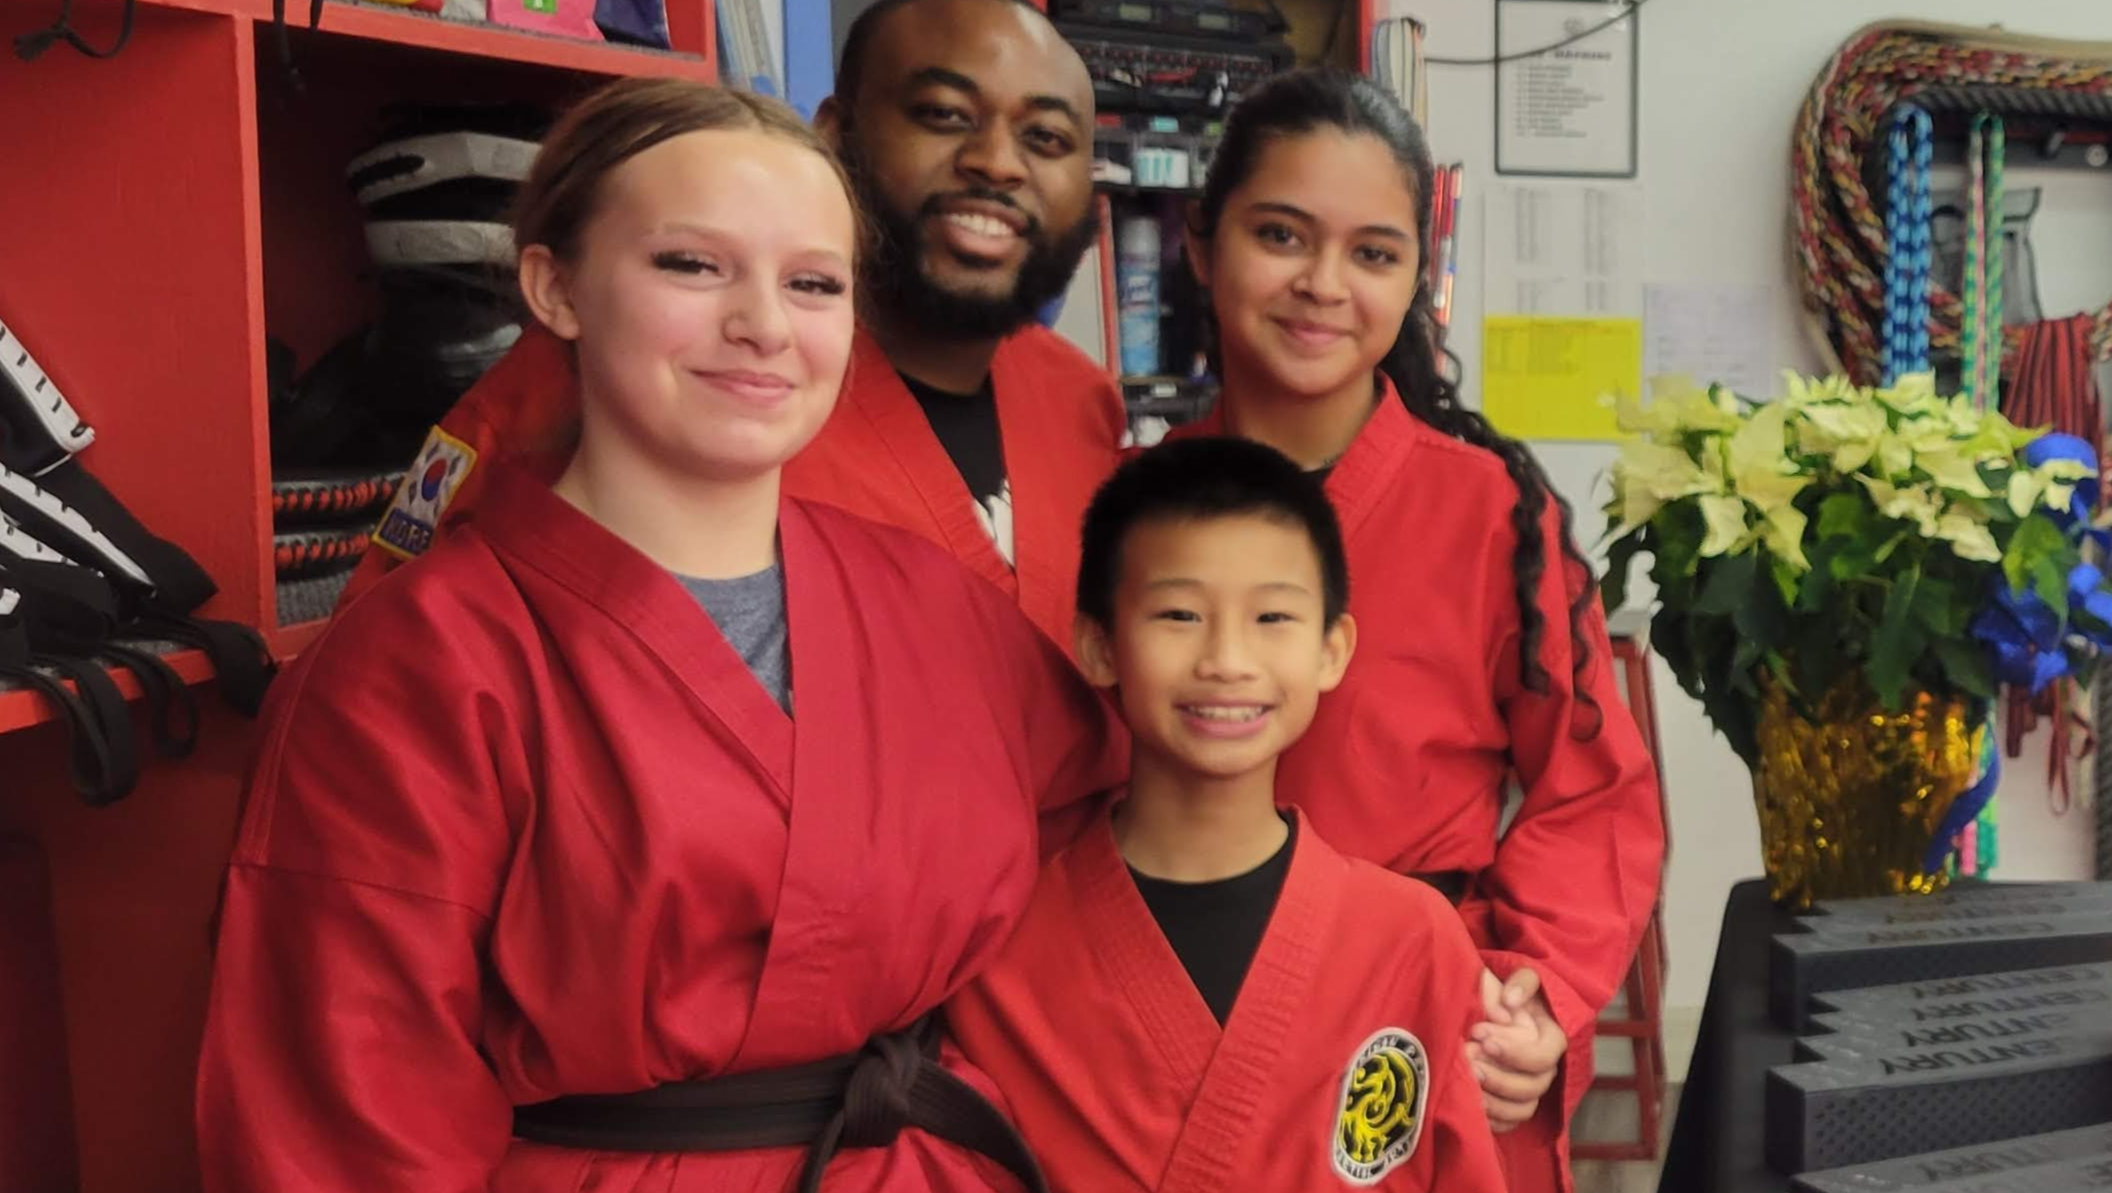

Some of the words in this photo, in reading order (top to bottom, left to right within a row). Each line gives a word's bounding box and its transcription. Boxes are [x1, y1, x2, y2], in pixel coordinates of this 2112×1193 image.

[383, 517, 431, 551] KORE
[1913, 969, 2102, 999] CENTURY
[1911, 990, 2109, 1020] CENTURY
[1878, 1038, 2068, 1075] ENTURY
